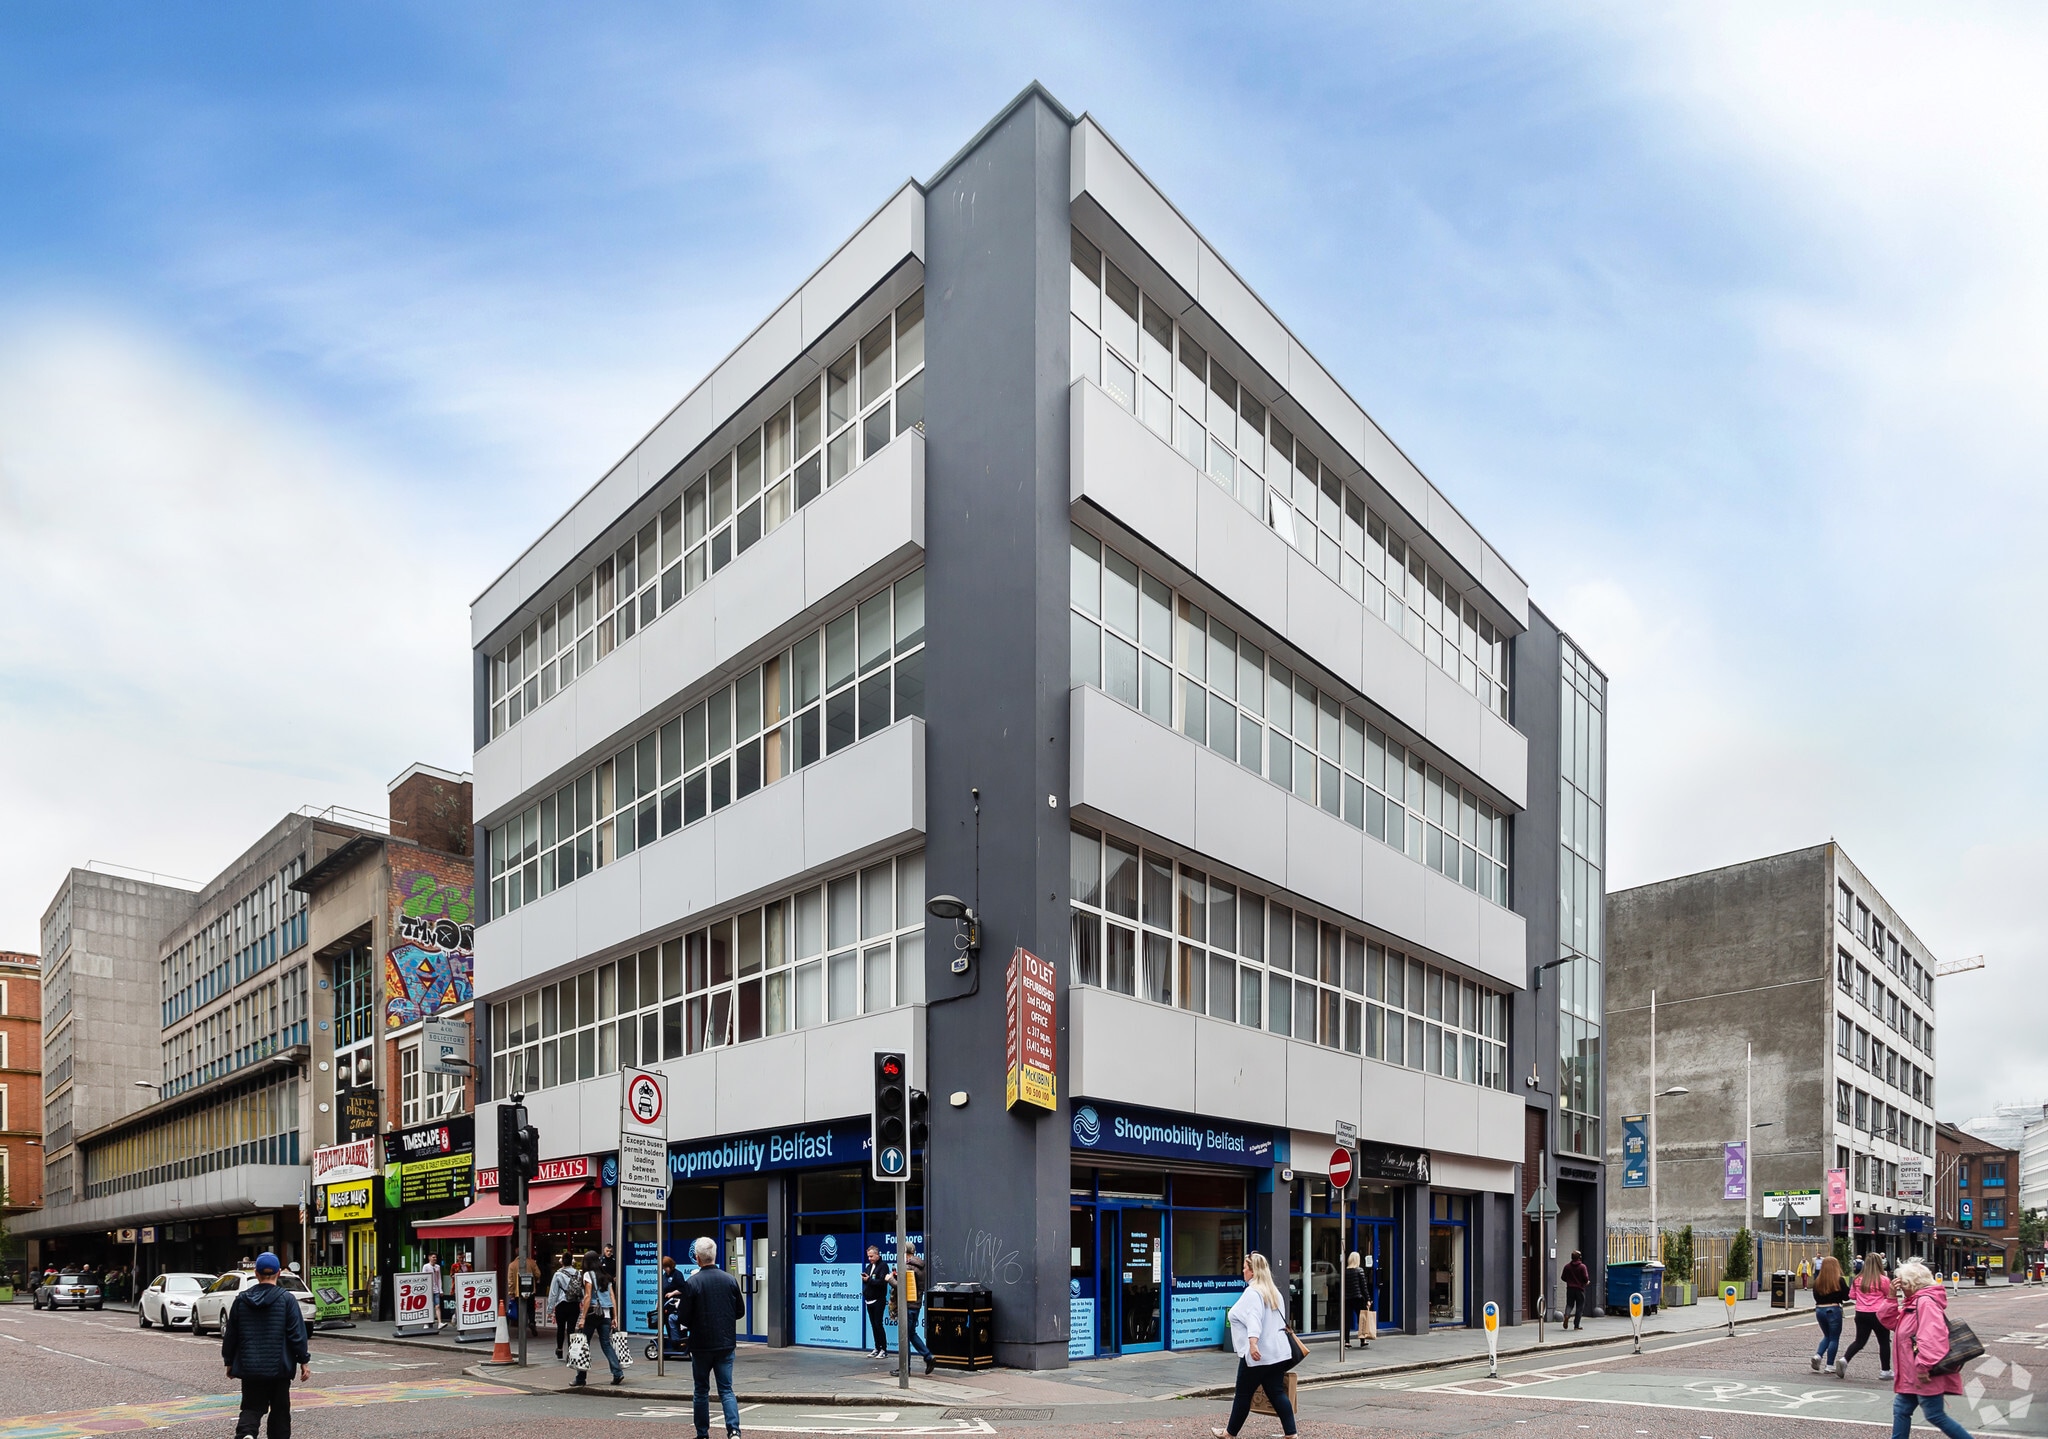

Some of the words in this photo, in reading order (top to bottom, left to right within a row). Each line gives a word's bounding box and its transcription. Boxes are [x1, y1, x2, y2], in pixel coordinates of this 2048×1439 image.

[1025, 955, 1037, 975] TO
[1039, 963, 1053, 985] LET
[1023, 976, 1054, 1002] REFURBISHED
[1027, 993, 1035, 1006] 2nd
[1036, 997, 1051, 1015] FLOOR
[1031, 1011, 1048, 1027] OFFICE
[429, 1034, 465, 1043] SOLICITORS
[1025, 1068, 1050, 1087] McKIBBIN
[1026, 1085, 1032, 1095] 90
[1033, 1088, 1041, 1099] 500
[1341, 1123, 1352, 1131] Except
[402, 1129, 440, 1151] TIMESCAPE
[1115, 1117, 1203, 1151] Shopmobility
[1206, 1129, 1244, 1152] Belfast
[627, 1136, 646, 1146] Except
[624, 1146, 643, 1154] permit
[644, 1148, 664, 1157] holders
[668, 1139, 765, 1178] hopmobility
[770, 1129, 833, 1162] Belfast
[318, 1147, 343, 1176] EXECUTIVE
[345, 1142, 368, 1169] BARBERS
[634, 1156, 654, 1165] loading
[482, 1170, 499, 1186] PRI
[538, 1159, 583, 1180] MEATS
[632, 1164, 656, 1173] between
[622, 1199, 646, 1207] Authorised
[311, 1265, 347, 1275] REPAIRS
[831, 1268, 846, 1276] enjoy
[400, 1285, 411, 1296] 3
[1191, 1281, 1202, 1289] help
[1216, 1281, 1226, 1289] your
[463, 1286, 476, 1298] 3
[808, 1292, 827, 1300] making
[400, 1295, 427, 1311] £10
[462, 1297, 492, 1313] £10
[401, 1310, 429, 1321] RANGE
[463, 1312, 495, 1324] RANGE
[813, 1314, 846, 1323] Volunteering
